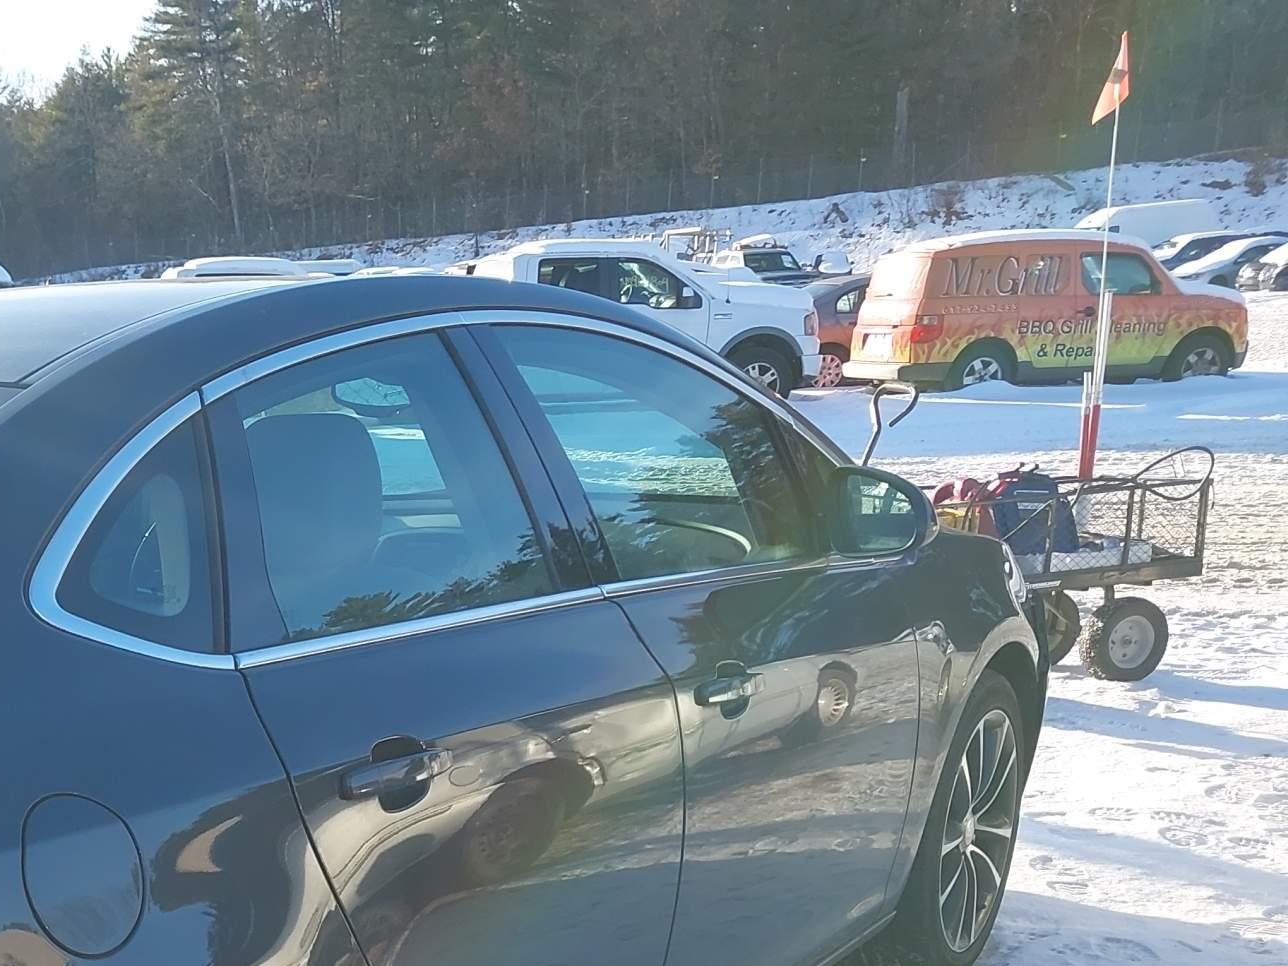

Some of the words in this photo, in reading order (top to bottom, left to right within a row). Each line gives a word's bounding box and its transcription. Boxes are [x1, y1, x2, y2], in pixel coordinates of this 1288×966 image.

[1017, 320, 1054, 335] BBQ
[1056, 319, 1092, 335] Grill
[1095, 318, 1167, 336] leaning
[1037, 343, 1048, 357] &
[1053, 343, 1096, 360] Repa
